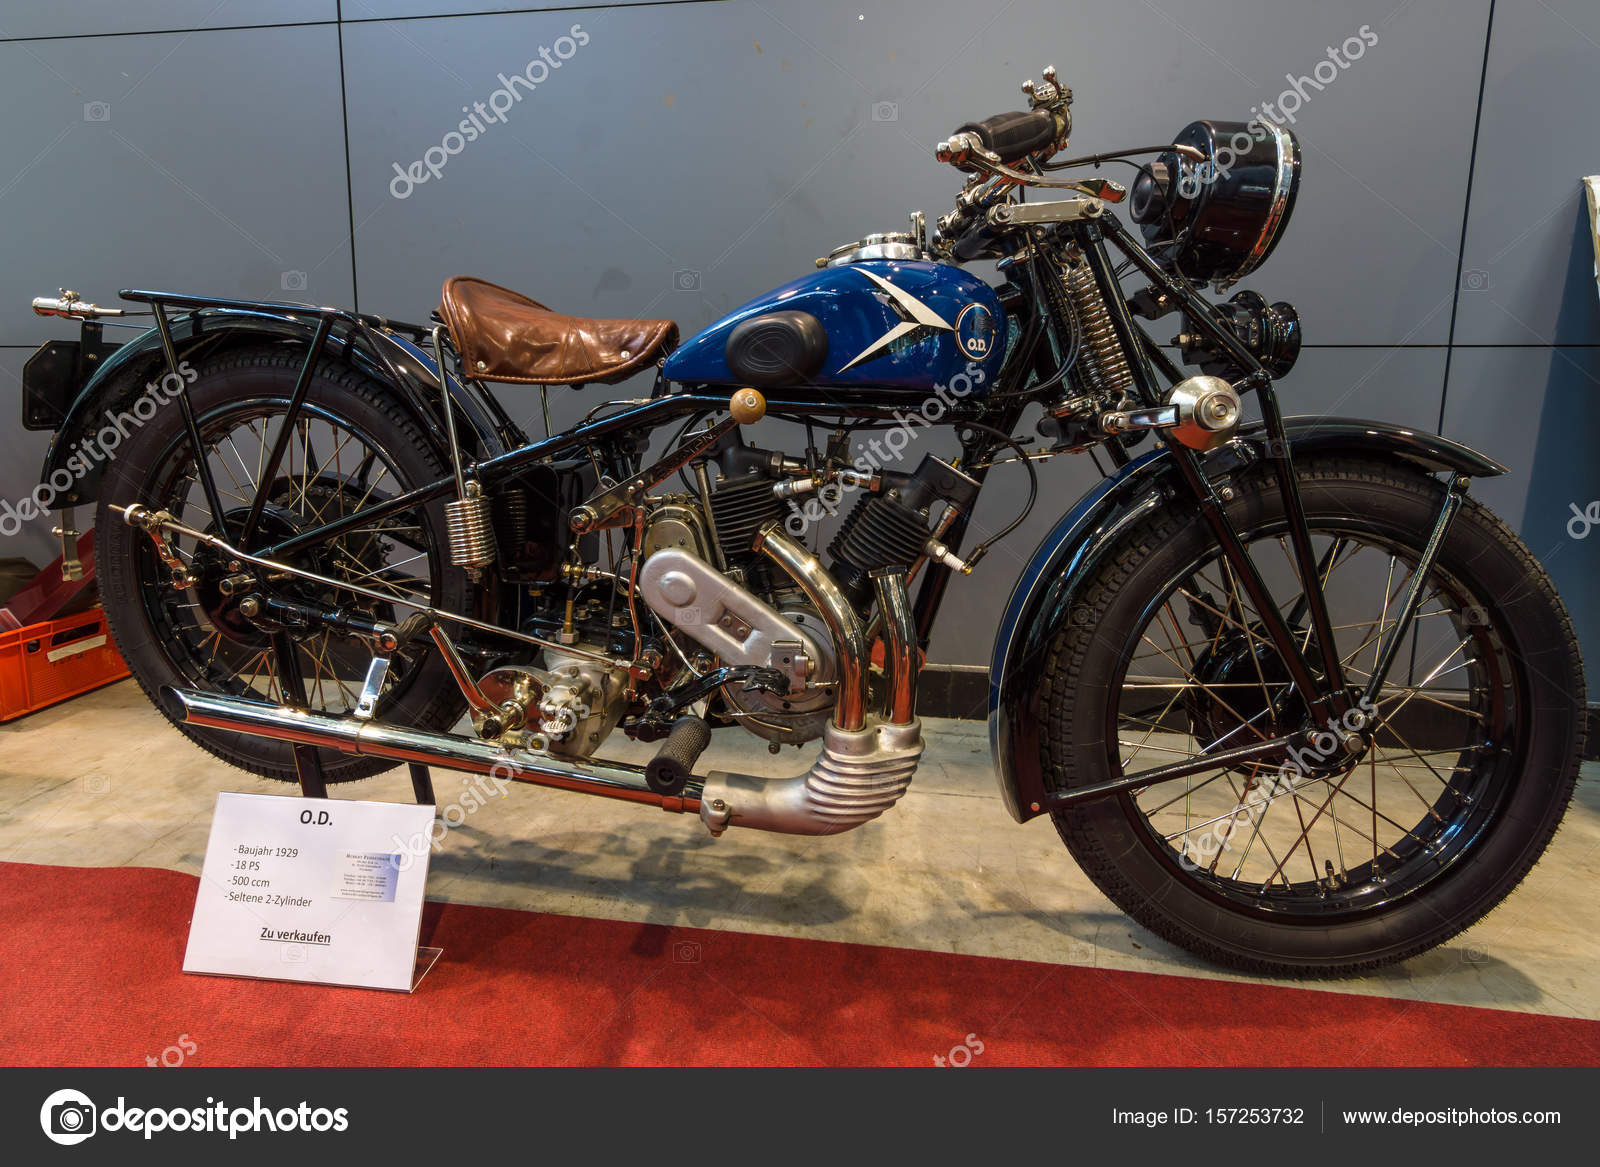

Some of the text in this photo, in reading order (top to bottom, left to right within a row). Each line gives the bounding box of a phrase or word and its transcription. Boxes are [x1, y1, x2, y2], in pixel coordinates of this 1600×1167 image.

[967, 337, 986, 352] O.D.
[300, 809, 333, 826] O.D.
[275, 847, 299, 858] 1929
[249, 861, 261, 871] PS
[251, 878, 270, 888] ccm
[265, 894, 313, 907] 2-Zylinder
[260, 927, 331, 944] Zu verkaufen
